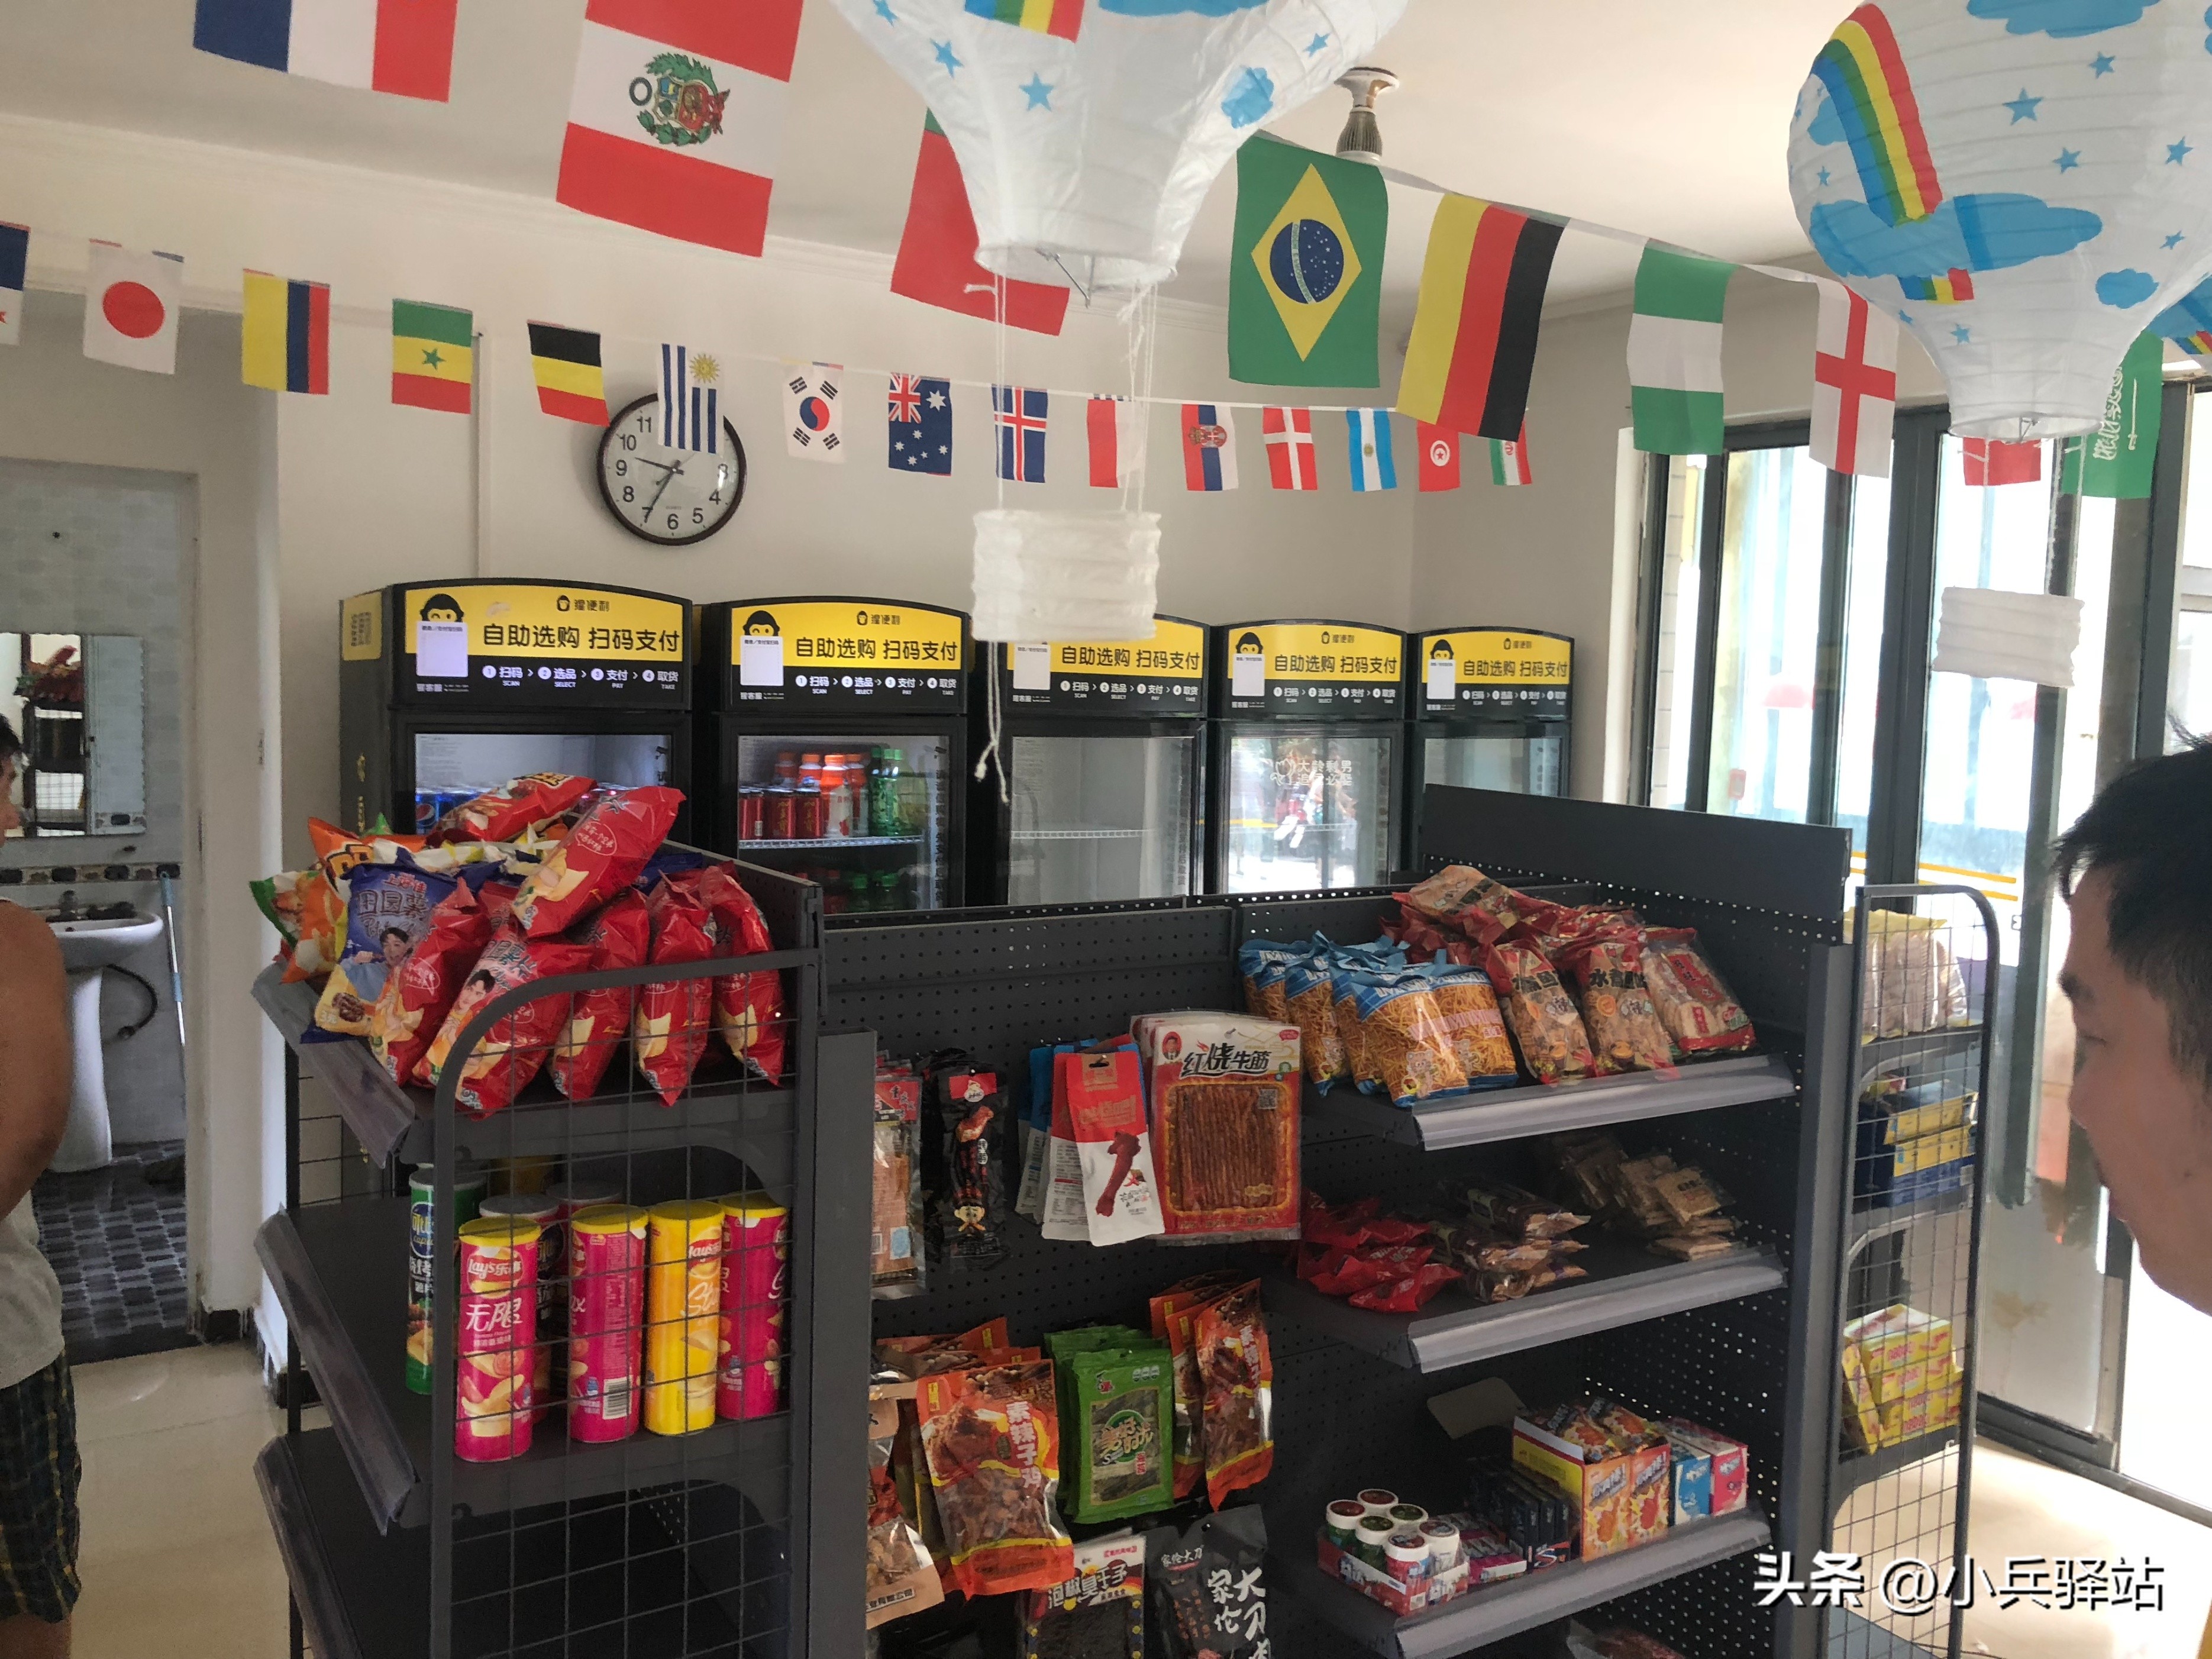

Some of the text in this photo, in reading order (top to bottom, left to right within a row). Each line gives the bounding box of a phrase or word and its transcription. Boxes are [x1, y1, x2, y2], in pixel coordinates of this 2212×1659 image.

[637, 416, 652, 432] 11
[619, 434, 637, 451] 10
[615, 459, 628, 476] 9
[718, 463, 729, 480] 3
[623, 486, 635, 503] 8
[709, 489, 721, 505] 4
[641, 506, 653, 523] 7
[667, 513, 679, 530] 6
[692, 507, 703, 524] 5
[483, 623, 680, 652] 自助选购 扫码支付
[796, 637, 958, 661] 自助选购 扫码支付
[1062, 646, 1200, 670] 自助选购 扫码支付
[1275, 654, 1397, 674] 自助选购 扫码支付
[499, 666, 523, 678] 扫码
[554, 668, 576, 680] 选品
[606, 670, 628, 681] 支付
[657, 671, 679, 682] 取货
[1464, 660, 1568, 677] 自助选购 扫码支付
[809, 676, 829, 687] 扫码
[854, 677, 874, 688] 选品
[897, 678, 916, 688] 支付
[939, 679, 957, 689] 取货
[357, 889, 430, 918] 田园薯
[1183, 1042, 1272, 1073] 红烧牛筋
[467, 1258, 496, 1279] Lay's
[466, 1298, 523, 1331] 无限
